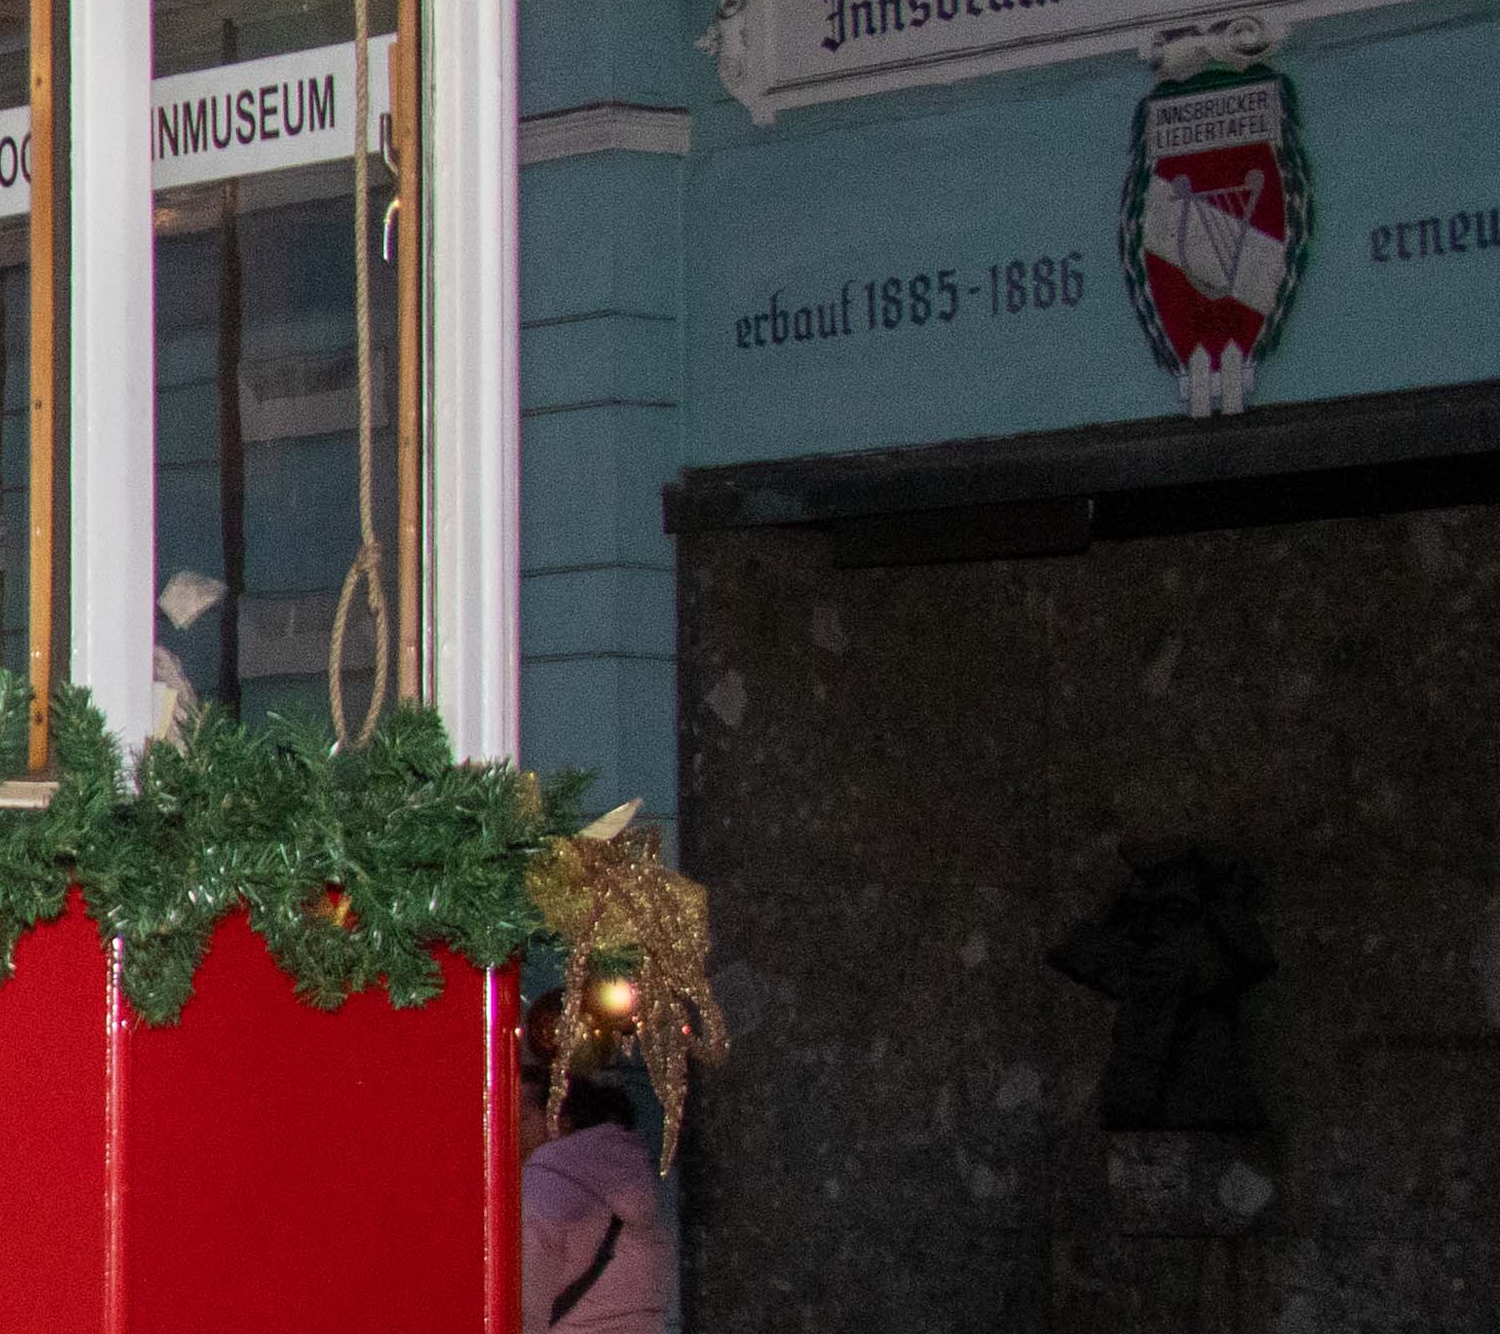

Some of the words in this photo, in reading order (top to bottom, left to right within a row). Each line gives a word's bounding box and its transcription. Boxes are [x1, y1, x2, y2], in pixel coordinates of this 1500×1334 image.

[151, 73, 336, 161] NMUSEUM
[1156, 90, 1269, 127] INNSBRUCKER
[1156, 113, 1269, 150] LIEDERTAFEL
